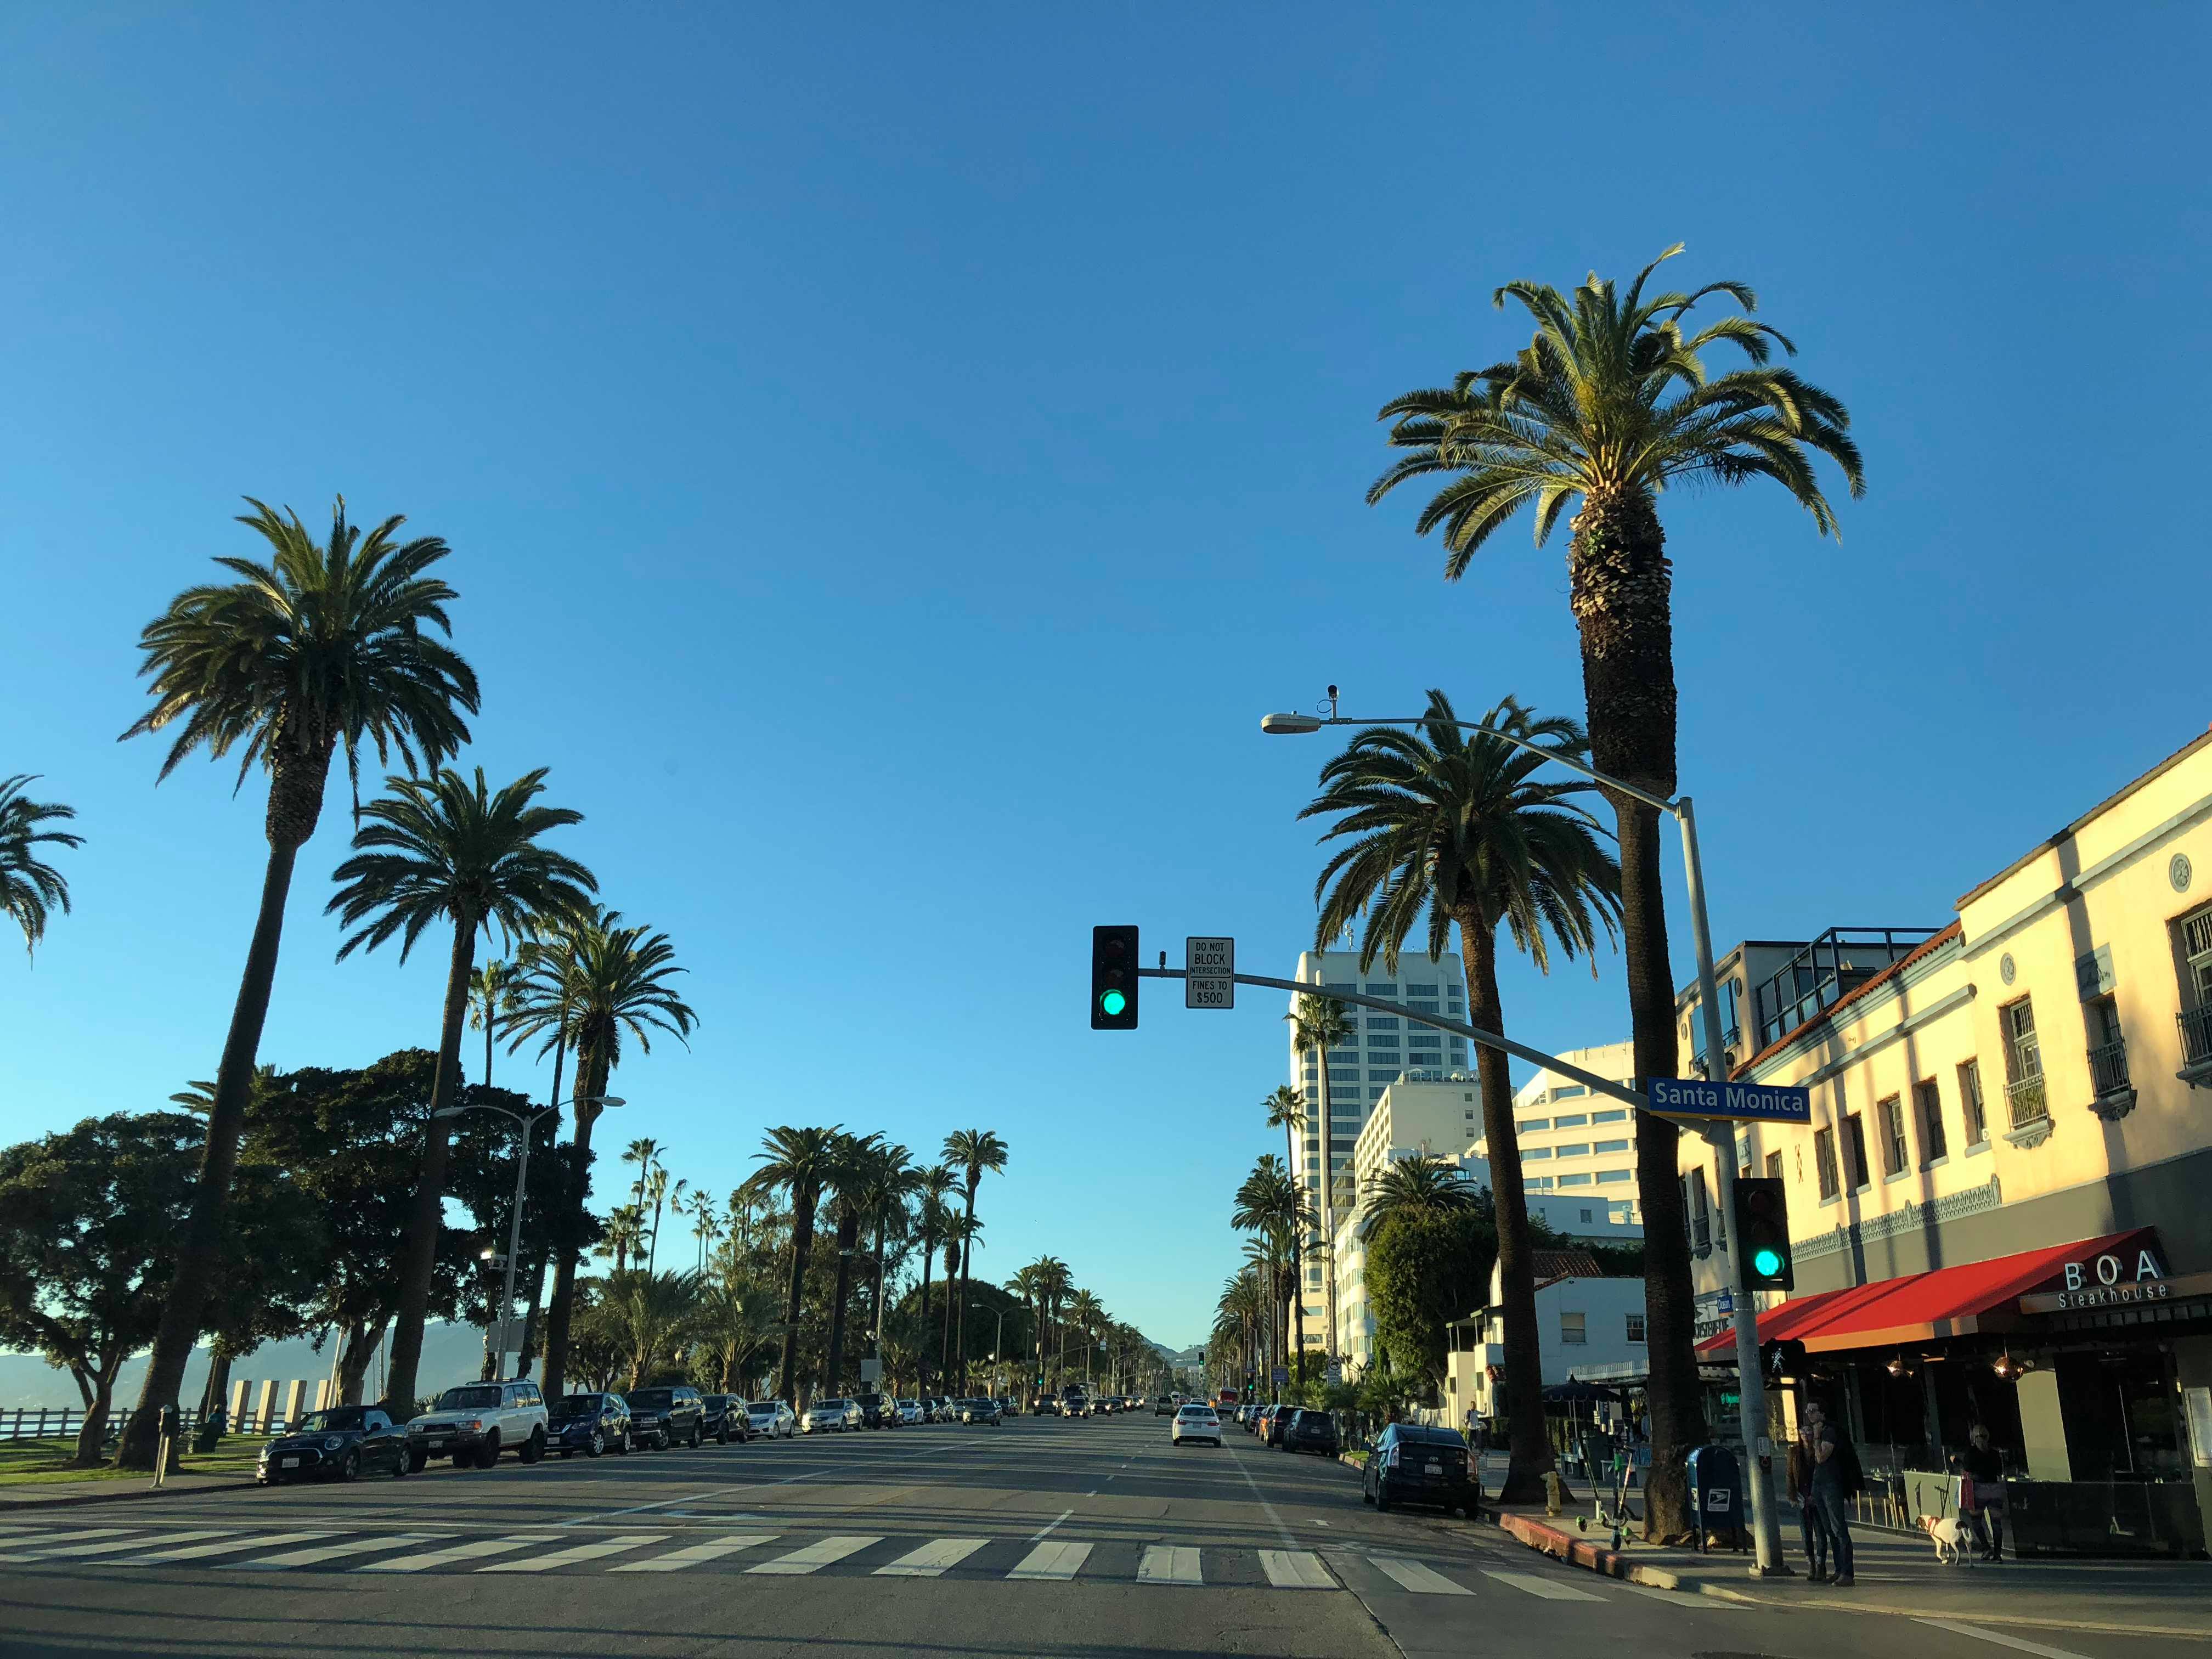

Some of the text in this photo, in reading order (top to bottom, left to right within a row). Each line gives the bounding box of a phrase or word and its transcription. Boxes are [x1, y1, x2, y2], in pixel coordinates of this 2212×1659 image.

[1196, 942, 1224, 951] DO NOT
[1195, 953, 1225, 964] BLOCK
[1193, 980, 1227, 990] FINES TO
[1197, 992, 1223, 1003] $500
[1655, 1082, 1803, 1111] Santa Monica
[2064, 1250, 2159, 1291] BOA
[2058, 1284, 2166, 1308] Steakhouse
